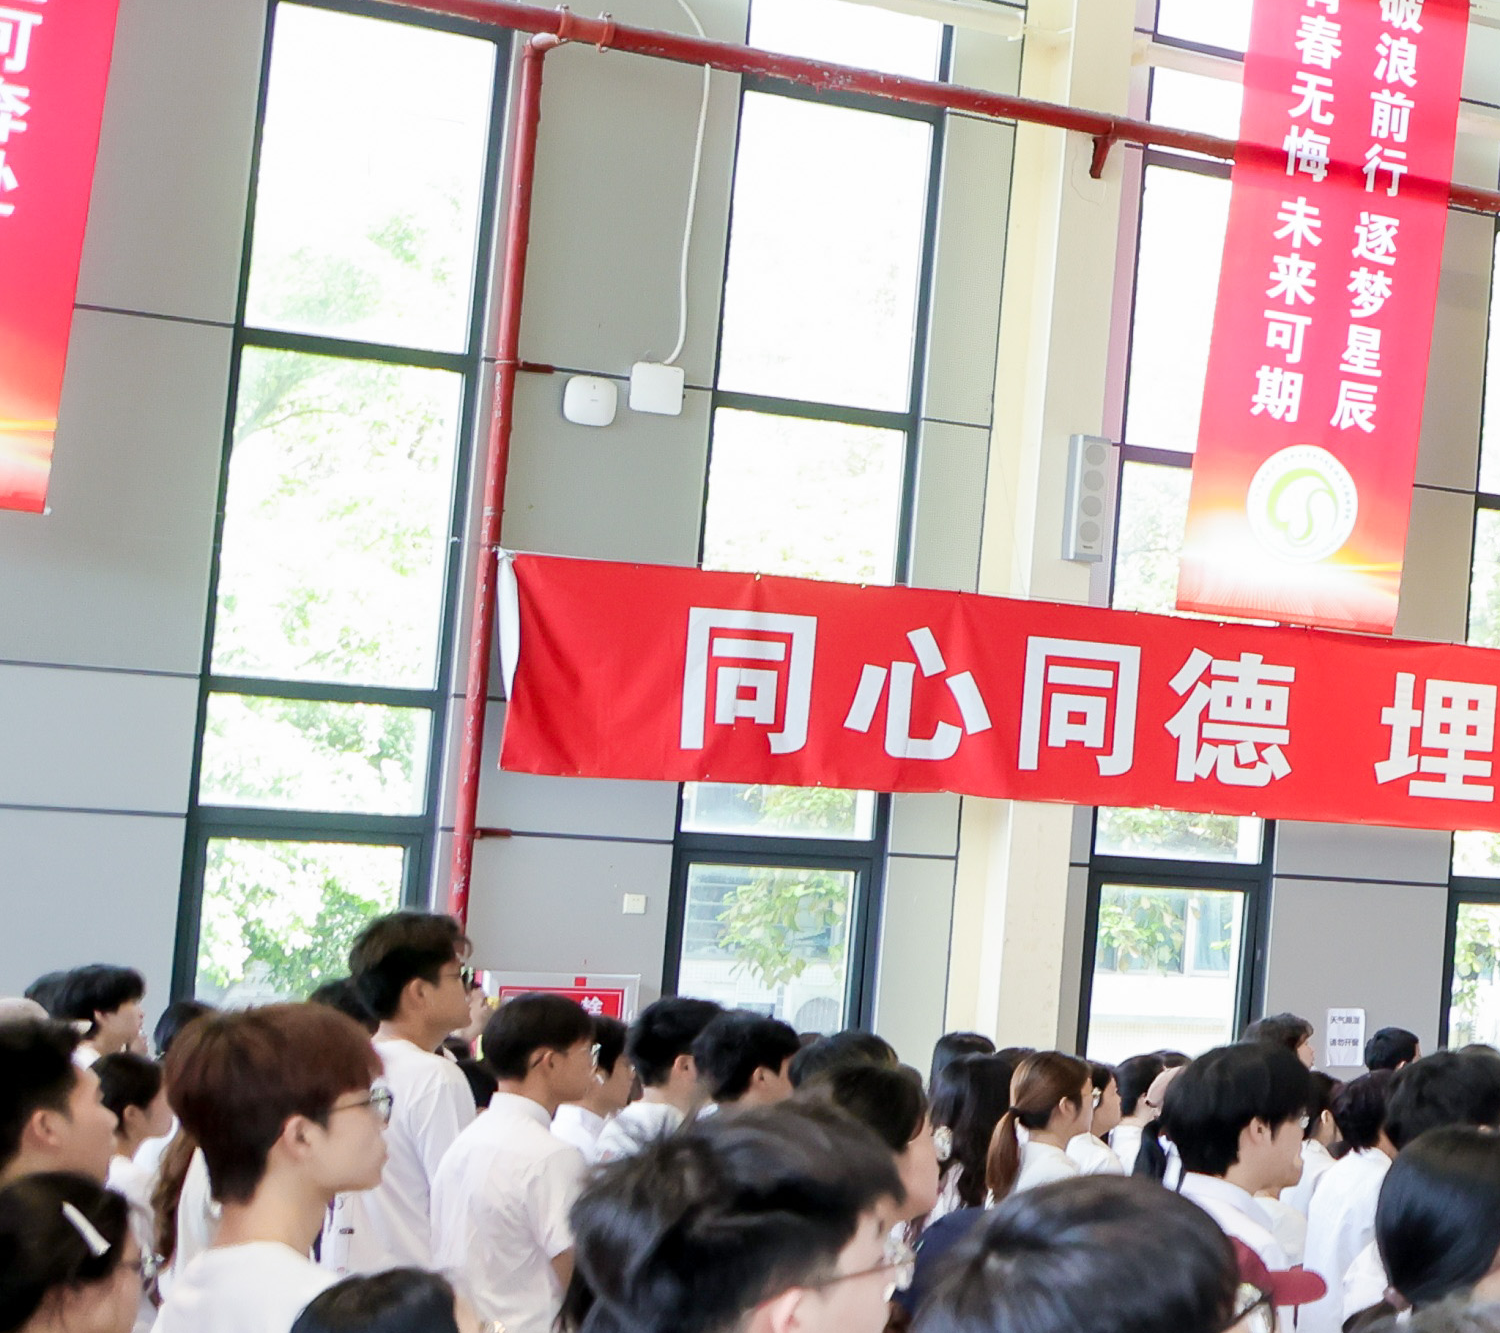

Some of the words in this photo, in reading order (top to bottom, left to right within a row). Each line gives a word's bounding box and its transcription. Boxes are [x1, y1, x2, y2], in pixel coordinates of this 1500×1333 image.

[1250, 196, 1322, 423] 未来可期
[1330, 211, 1400, 433] 逐梦星辰
[678, 606, 1296, 787] 同心同德
